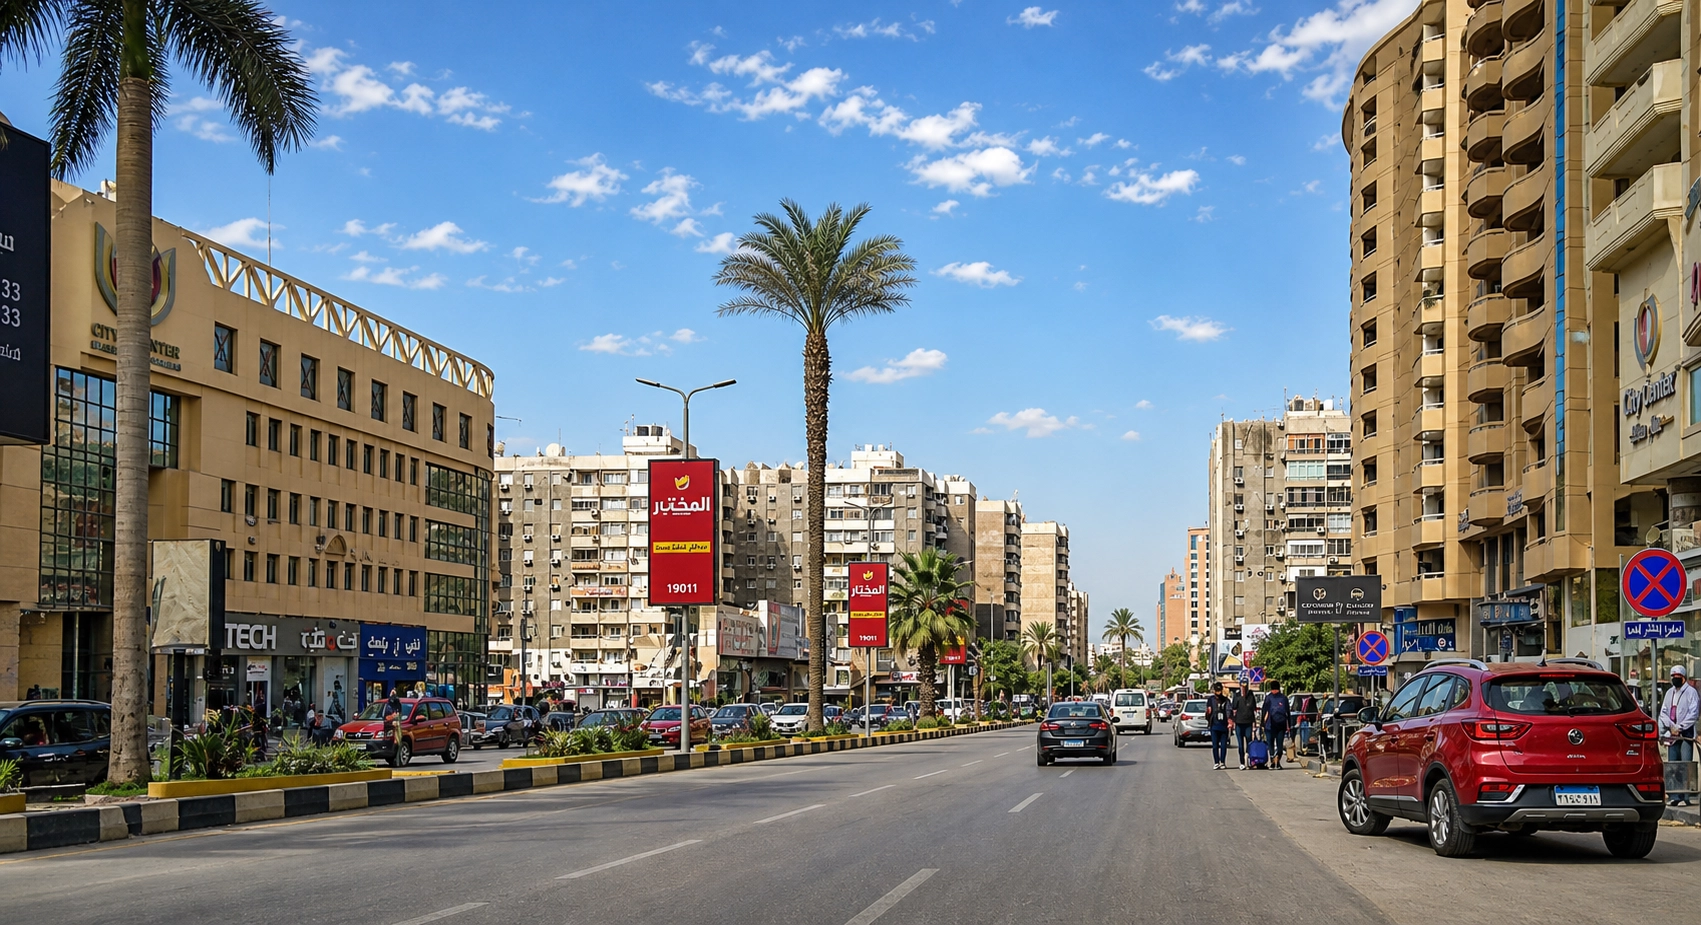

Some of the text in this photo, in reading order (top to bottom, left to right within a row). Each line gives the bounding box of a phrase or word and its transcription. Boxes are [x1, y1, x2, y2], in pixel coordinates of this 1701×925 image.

[150, 339, 181, 360] NTER
[667, 583, 697, 594] 19011
[225, 623, 277, 650] TECH
